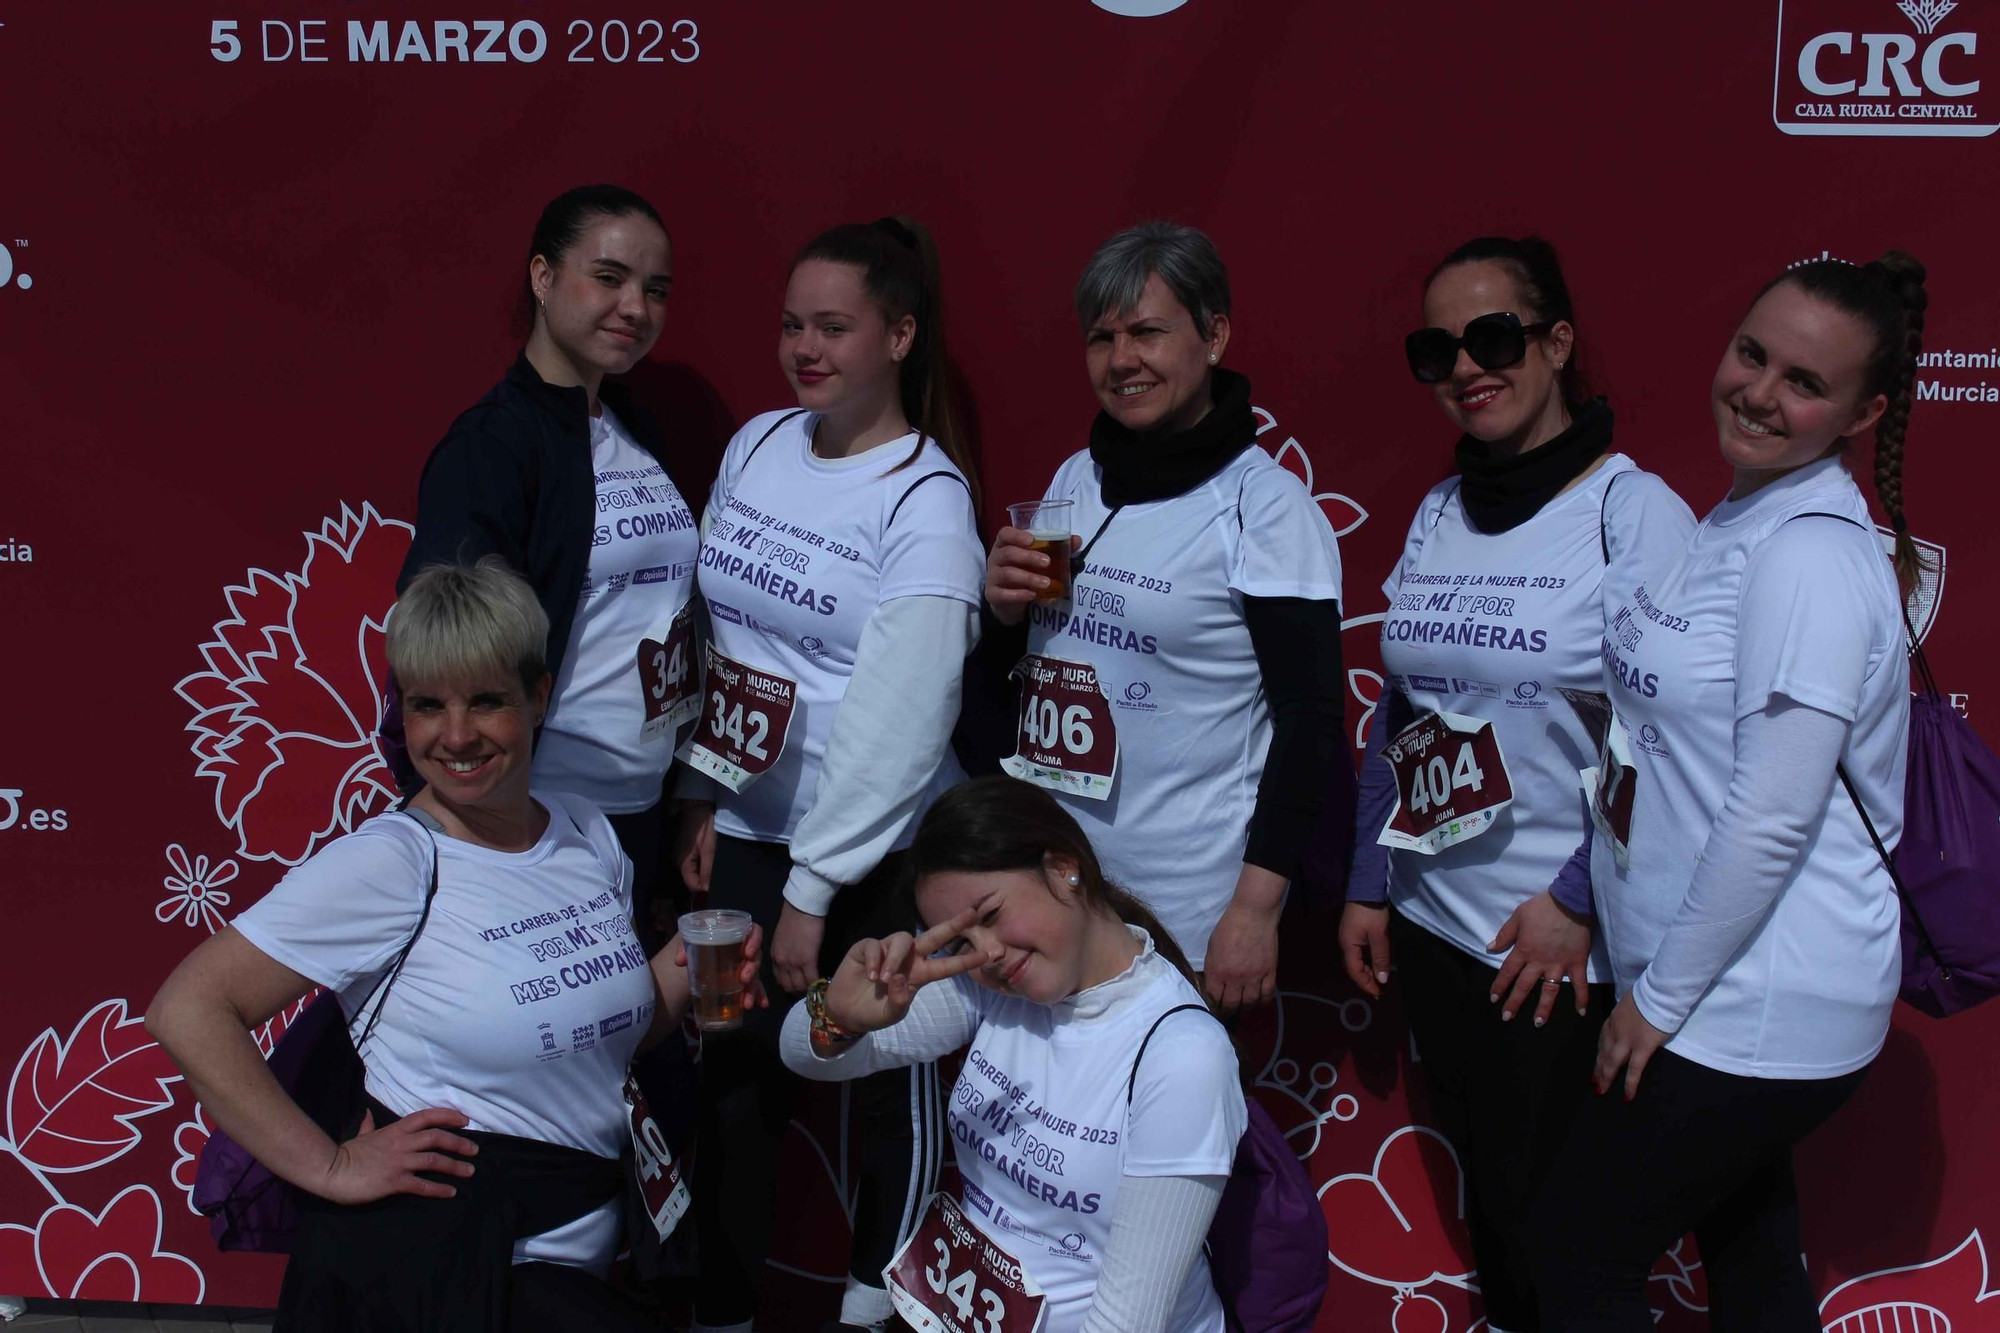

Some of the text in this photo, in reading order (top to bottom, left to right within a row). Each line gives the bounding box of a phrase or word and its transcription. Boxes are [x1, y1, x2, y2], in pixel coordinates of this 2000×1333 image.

[209, 19, 701, 63] 5 DE MARZO 2023
[1797, 31, 1980, 97] CRC
[1795, 103, 1977, 119] CAJA RURAL CENTRAL
[1915, 347, 2000, 369] untami
[1917, 380, 1999, 402] Murcia
[595, 470, 627, 486] ARRERA
[645, 465, 665, 478] MUJE
[596, 480, 682, 513] POR MÍ Y PO
[616, 504, 695, 540] COMPAÑE
[726, 496, 861, 562] CARRERA DE LA MUJER 2023
[730, 526, 766, 550] MÍ
[757, 538, 775, 556] Y
[769, 543, 810, 575] POR
[699, 543, 838, 617] COMPAÑERAS
[1084, 563, 1172, 594] LA MUJER 2023
[1411, 573, 1451, 586] CARRERA
[1452, 575, 1469, 586] DE
[1469, 575, 1483, 586] LA
[1485, 576, 1527, 588] MUJER
[1530, 576, 1566, 589] 2023
[1077, 585, 1126, 618] Y POR
[1425, 587, 1461, 612] MÍ
[1457, 596, 1471, 613] Y
[1470, 595, 1515, 617] POR
[1029, 602, 1157, 655] OMPAÑERAS
[1386, 617, 1548, 653] COMPAÑERAS
[1659, 614, 1691, 633] 2023
[747, 673, 790, 699] MURCIA
[1063, 667, 1097, 684] MURC
[1070, 684, 1093, 693] MARZO
[755, 690, 776, 702] MARZO
[776, 697, 790, 708] 2023
[710, 690, 769, 762] 342
[1024, 694, 1094, 755] 406
[1032, 751, 1063, 767] PALOMA
[1408, 729, 1436, 758] mujer
[1411, 741, 1484, 815] 404
[1434, 807, 1456, 824] JUANI
[478, 926, 511, 943] VIII
[511, 911, 562, 936] CARRERA
[560, 904, 580, 922] DE
[527, 936, 575, 963] POR
[565, 918, 599, 951] MÍ
[591, 920, 614, 942] Y
[510, 974, 562, 1006] MIS
[970, 1049, 1012, 1095] CARRERA
[1010, 1086, 1028, 1105] DE
[1025, 1101, 1040, 1120] LA
[1080, 1127, 1118, 1145] 2023
[982, 1100, 1016, 1137] MÍ
[1011, 1123, 1026, 1148] Y
[1023, 1135, 1065, 1176] POR
[948, 1110, 1101, 1214] COMPAÑERAS
[983, 1242, 1023, 1283] MURC
[1049, 1245, 1067, 1256] Pacto
[925, 1237, 1006, 1333] 343
[992, 1269, 1016, 1289] MARZO
